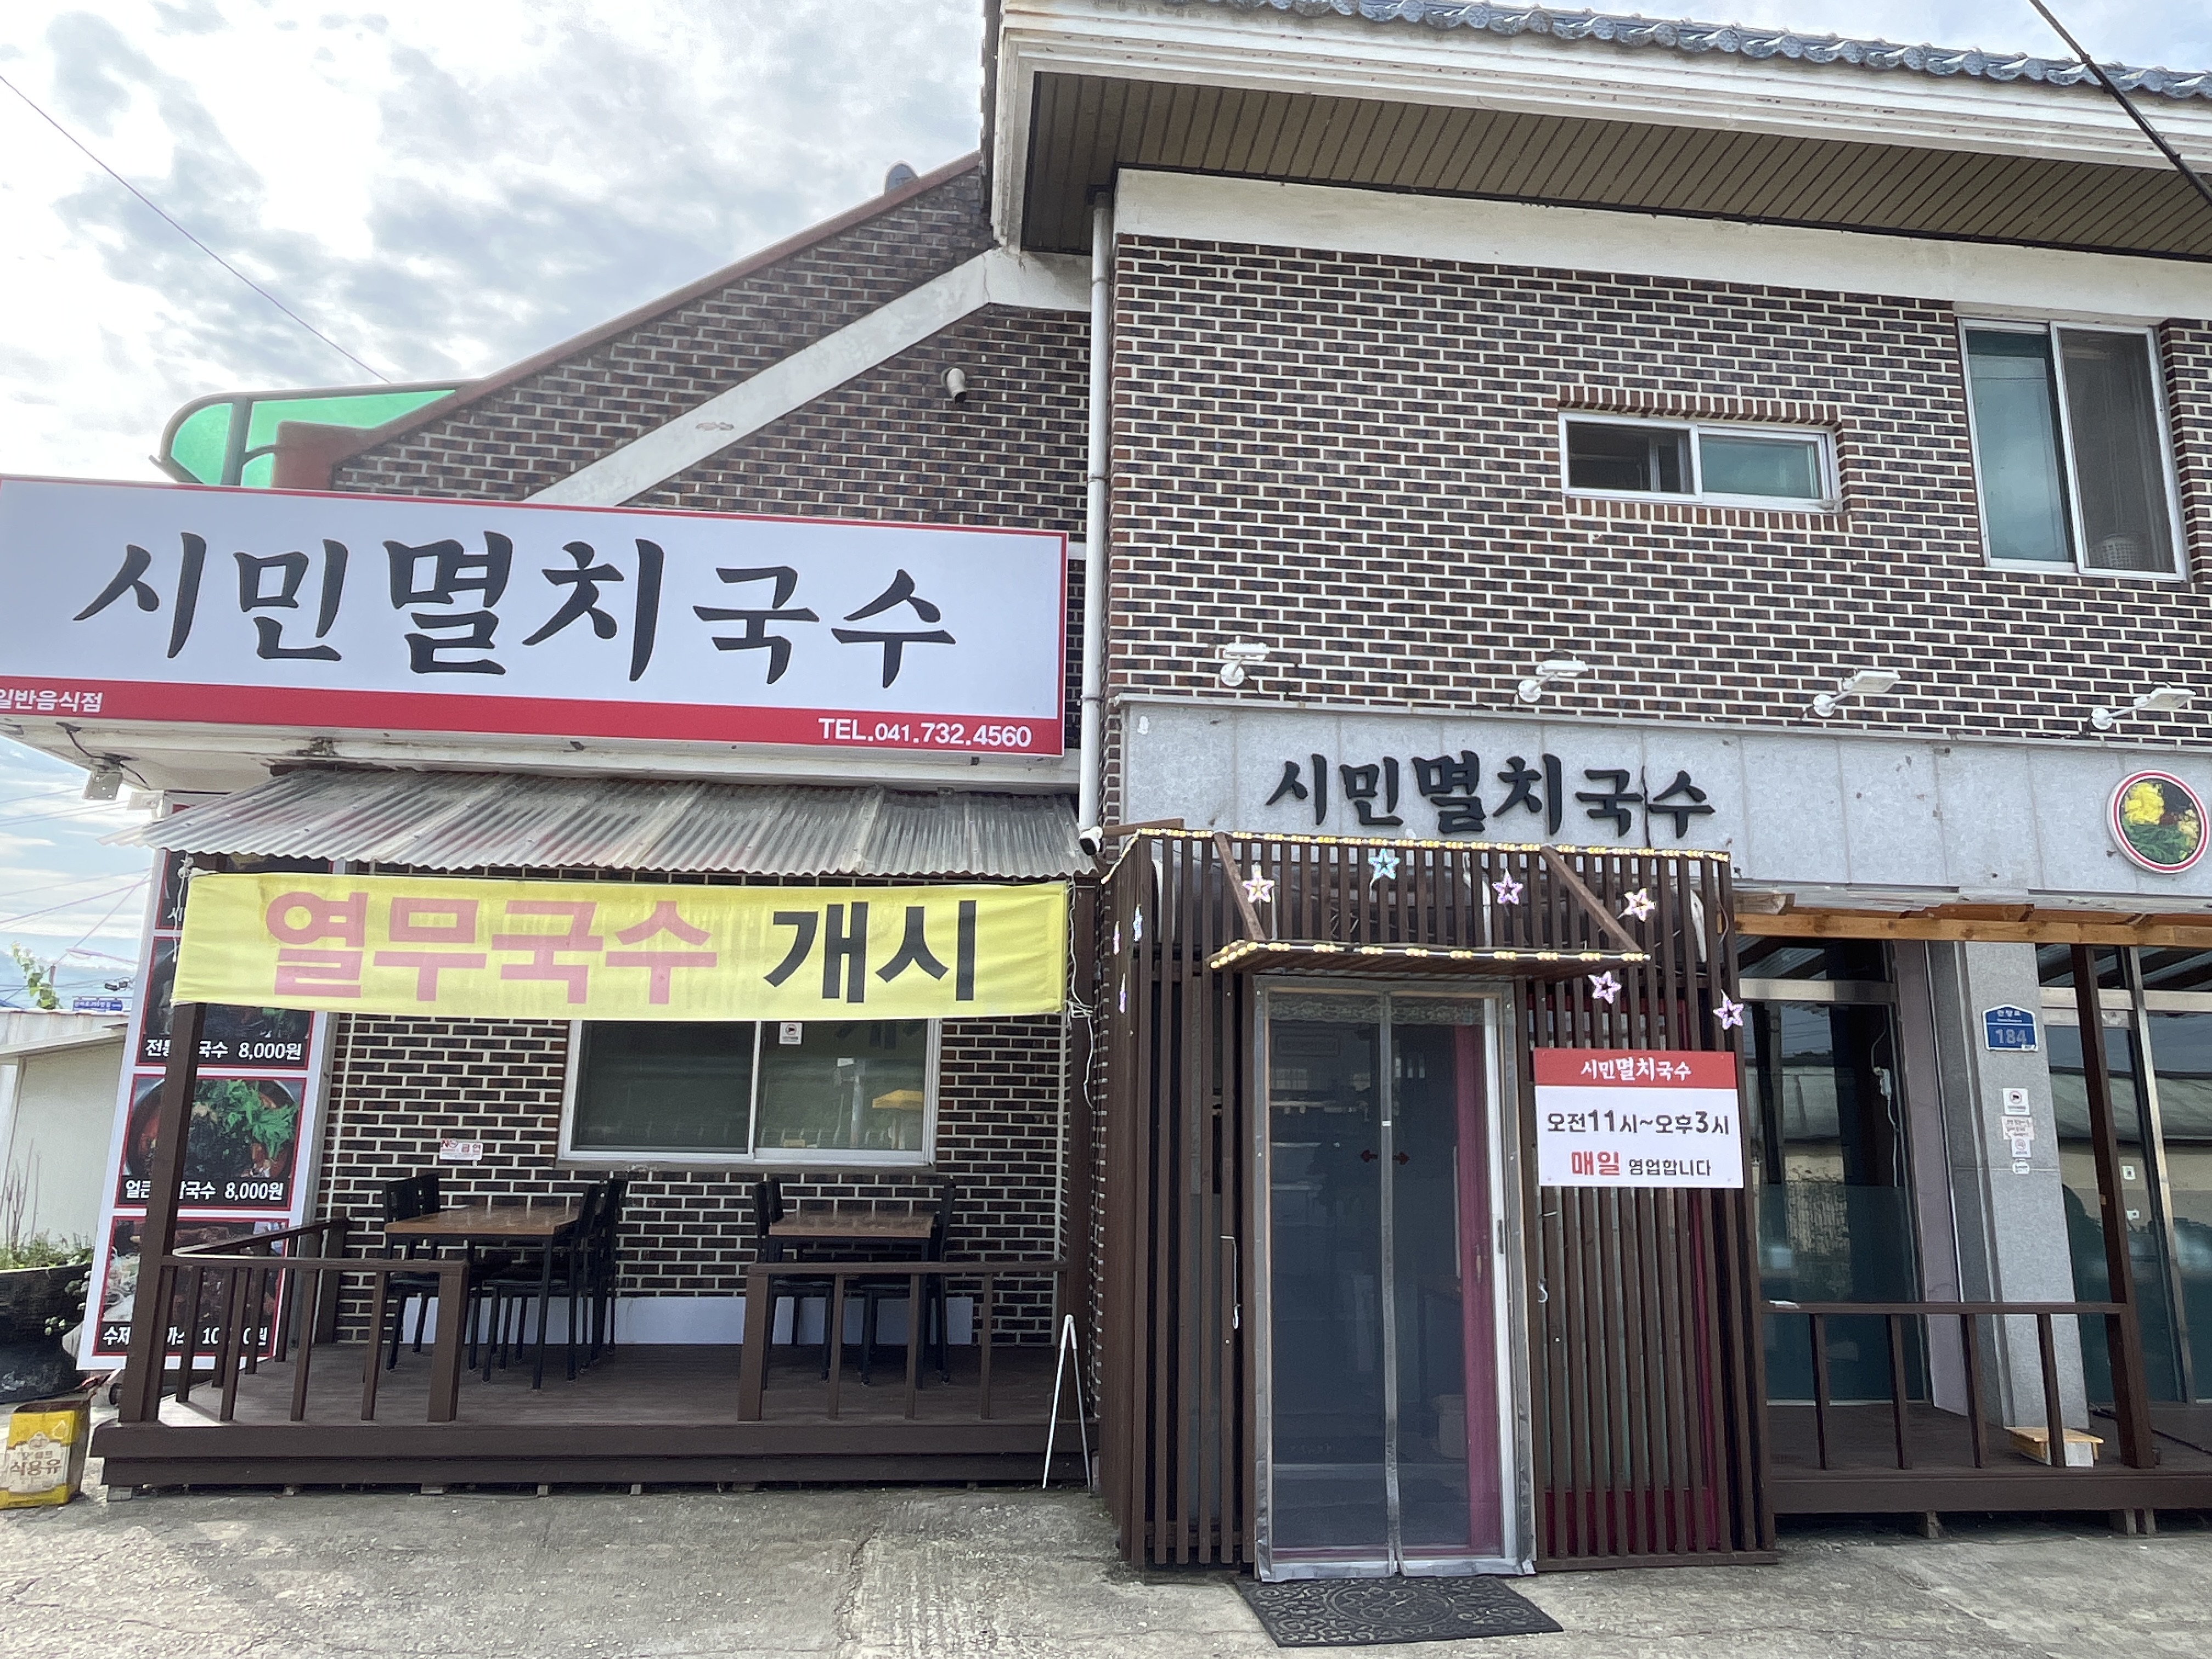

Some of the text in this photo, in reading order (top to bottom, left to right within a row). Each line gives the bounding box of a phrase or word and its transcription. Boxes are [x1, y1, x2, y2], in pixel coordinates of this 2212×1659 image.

[72, 531, 956, 689] 시민멸치국수
[0, 688, 103, 713] 일반음식점
[818, 718, 1032, 748] TEL.041.732.4560
[1265, 750, 1716, 838] 시민멸치국수
[266, 891, 977, 1005] 열무국수 개시
[1996, 1028, 2027, 1045] 184
[238, 1042, 302, 1060] 8,000원
[1581, 1057, 1691, 1081] 시민멸치국수
[1571, 1151, 1711, 1177] 매일 영업합니다
[225, 1182, 284, 1201] 8,000원
[10, 1458, 61, 1476] 식용유
